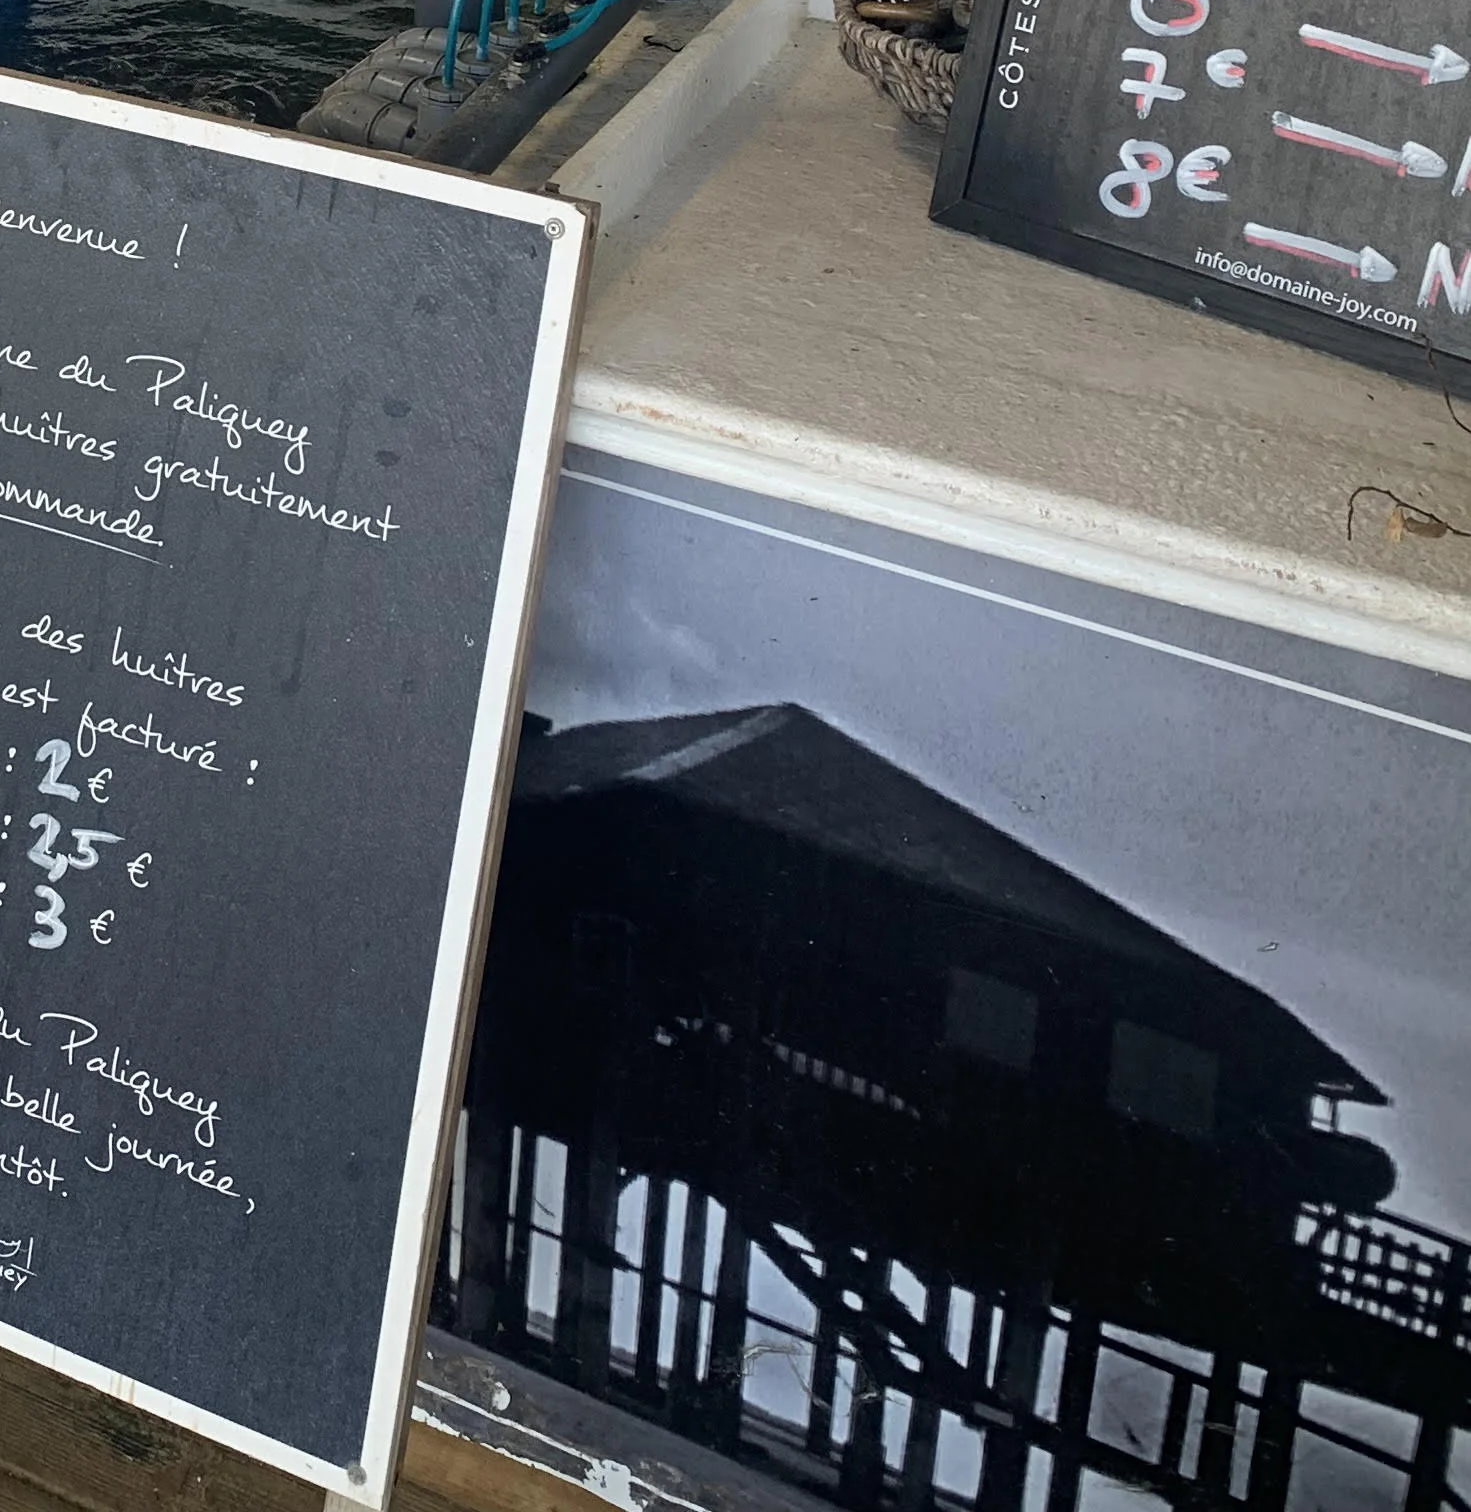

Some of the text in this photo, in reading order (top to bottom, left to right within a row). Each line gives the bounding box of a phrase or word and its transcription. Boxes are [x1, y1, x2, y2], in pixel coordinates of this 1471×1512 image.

[1195, 246, 1418, 333] info@domaine-joy.com
[59, 354, 117, 392] du
[127, 355, 313, 475] Paliquey
[143, 453, 402, 543] gratuitement
[21, 615, 83, 654] des
[113, 626, 245, 707] huîtres
[2, 679, 59, 714] est
[78, 702, 223, 773] facturé
[0, 1074, 82, 1134] belle
[39, 1012, 222, 1147] Paliquey
